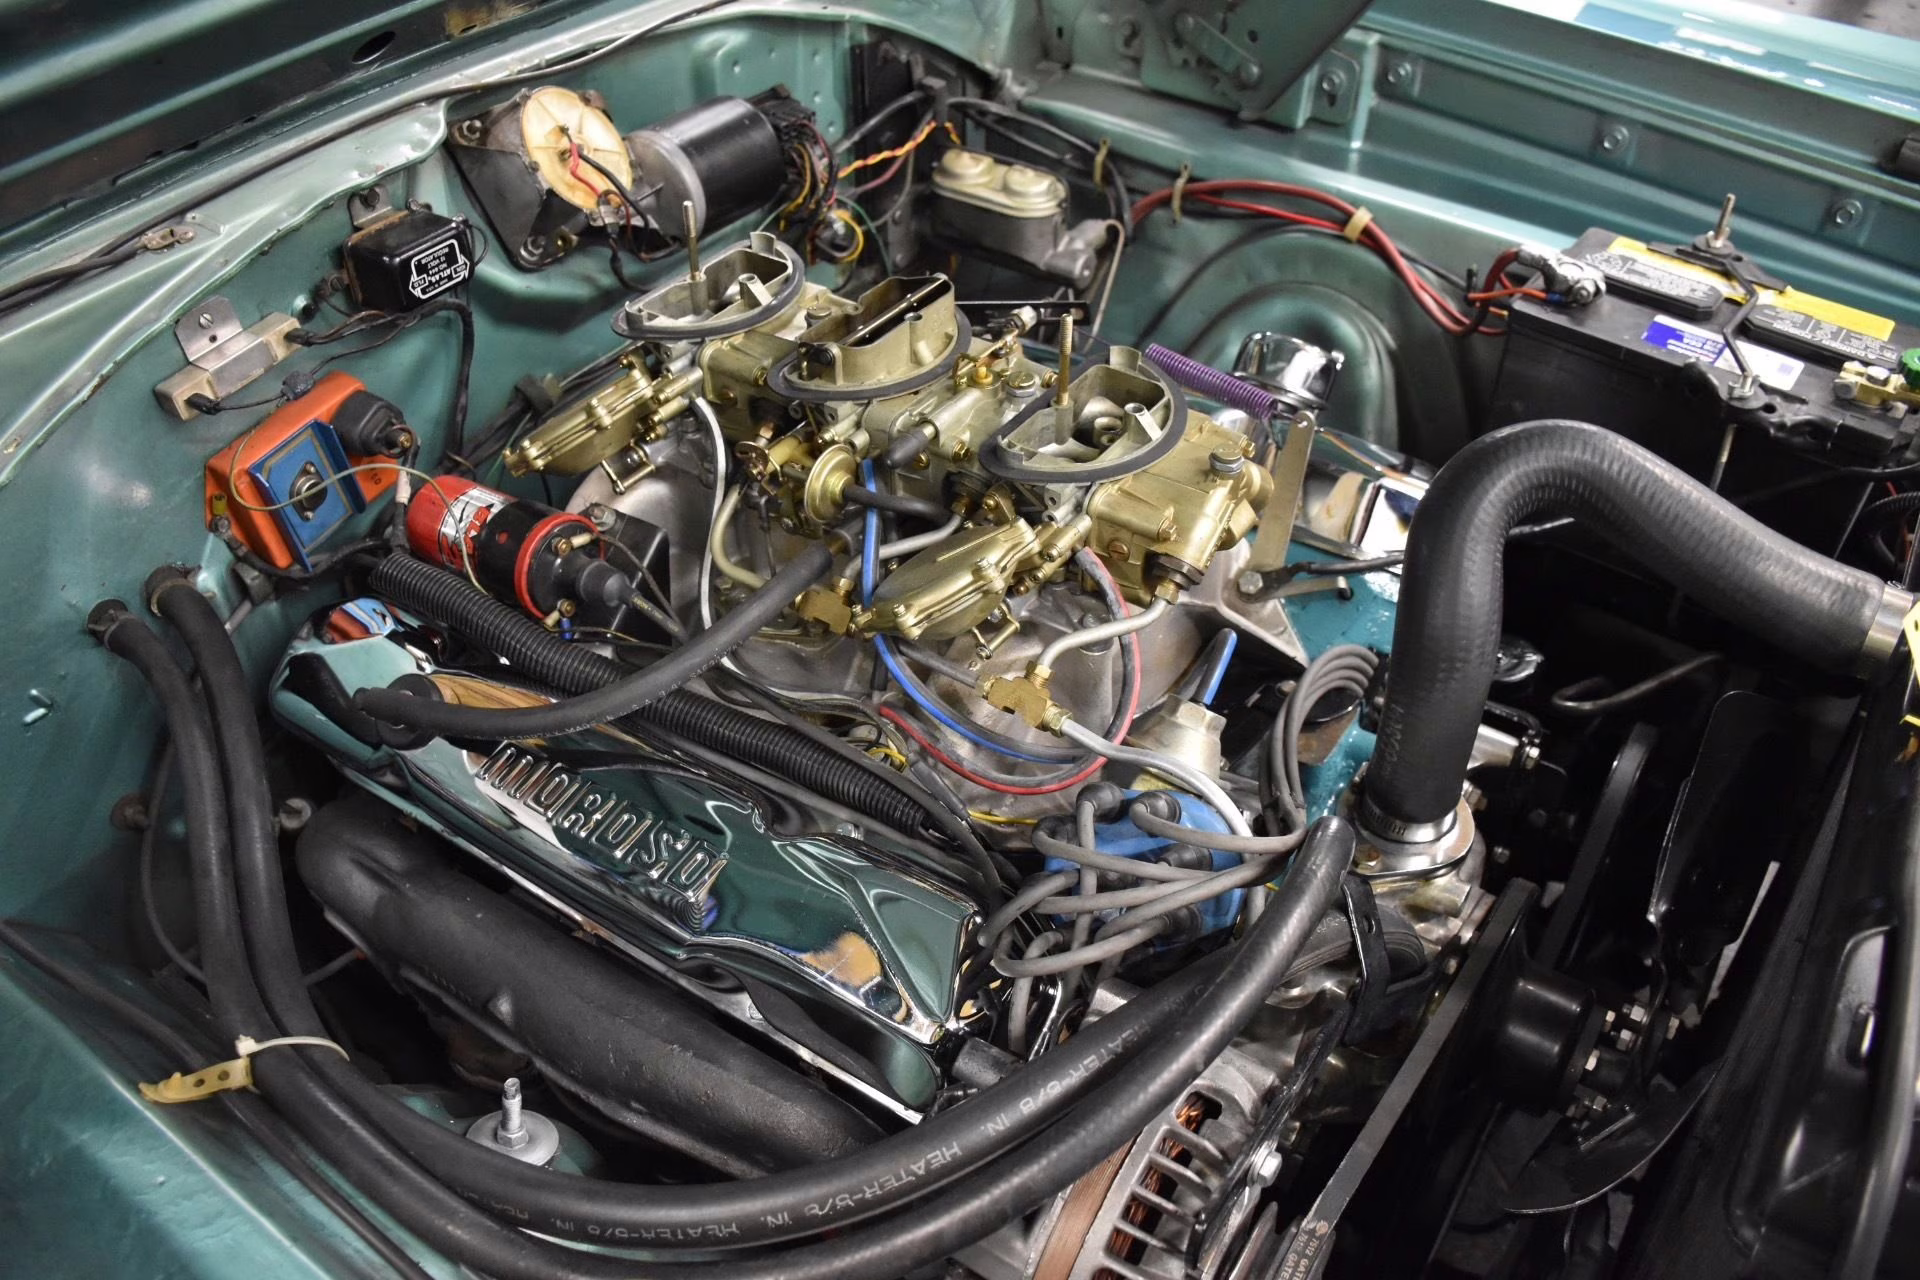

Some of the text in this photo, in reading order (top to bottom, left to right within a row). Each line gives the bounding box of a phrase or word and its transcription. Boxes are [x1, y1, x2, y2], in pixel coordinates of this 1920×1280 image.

[421, 247, 449, 264] REGULATOR
[428, 259, 440, 269] VOLT
[431, 268, 450, 283] ATLAS
[476, 740, 729, 902] MOROSO
[981, 1020, 1149, 1136] HEATER-5/8 IN.
[760, 1141, 962, 1228] HEATER-5/8 IN.
[551, 1217, 575, 1232] IN.
